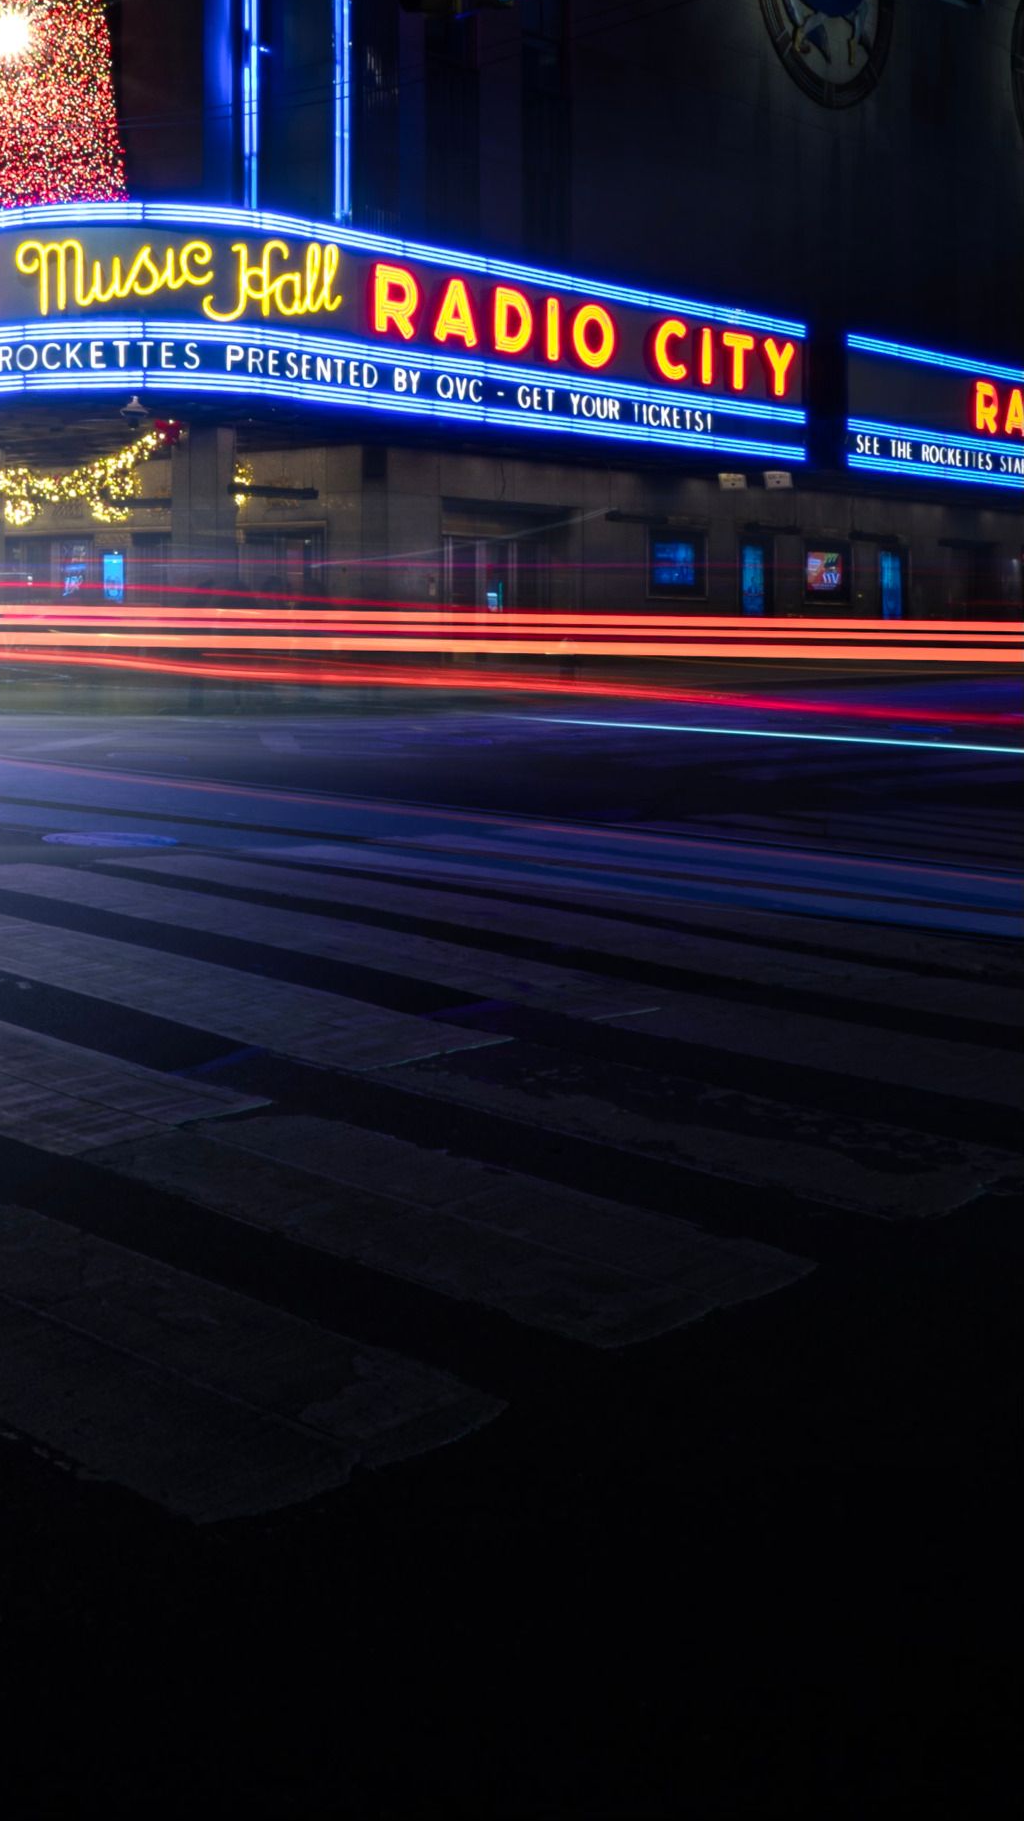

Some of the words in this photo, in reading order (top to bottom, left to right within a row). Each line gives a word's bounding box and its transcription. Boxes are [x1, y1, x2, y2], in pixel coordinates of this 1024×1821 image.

[15, 238, 214, 317] Music
[202, 240, 343, 322] Hall
[373, 263, 616, 369] RADIO
[653, 318, 795, 396] CITY
[225, 344, 378, 388] PRESENTED
[394, 367, 421, 394] BY
[436, 374, 483, 402] QVC
[517, 385, 556, 412] GET
[569, 391, 621, 420] YOUR
[631, 400, 712, 433] TICKETS!
[975, 381, 1024, 437] RA
[856, 434, 880, 456] SEE
[890, 438, 913, 460] THE
[921, 443, 993, 471] ROCKETTES
